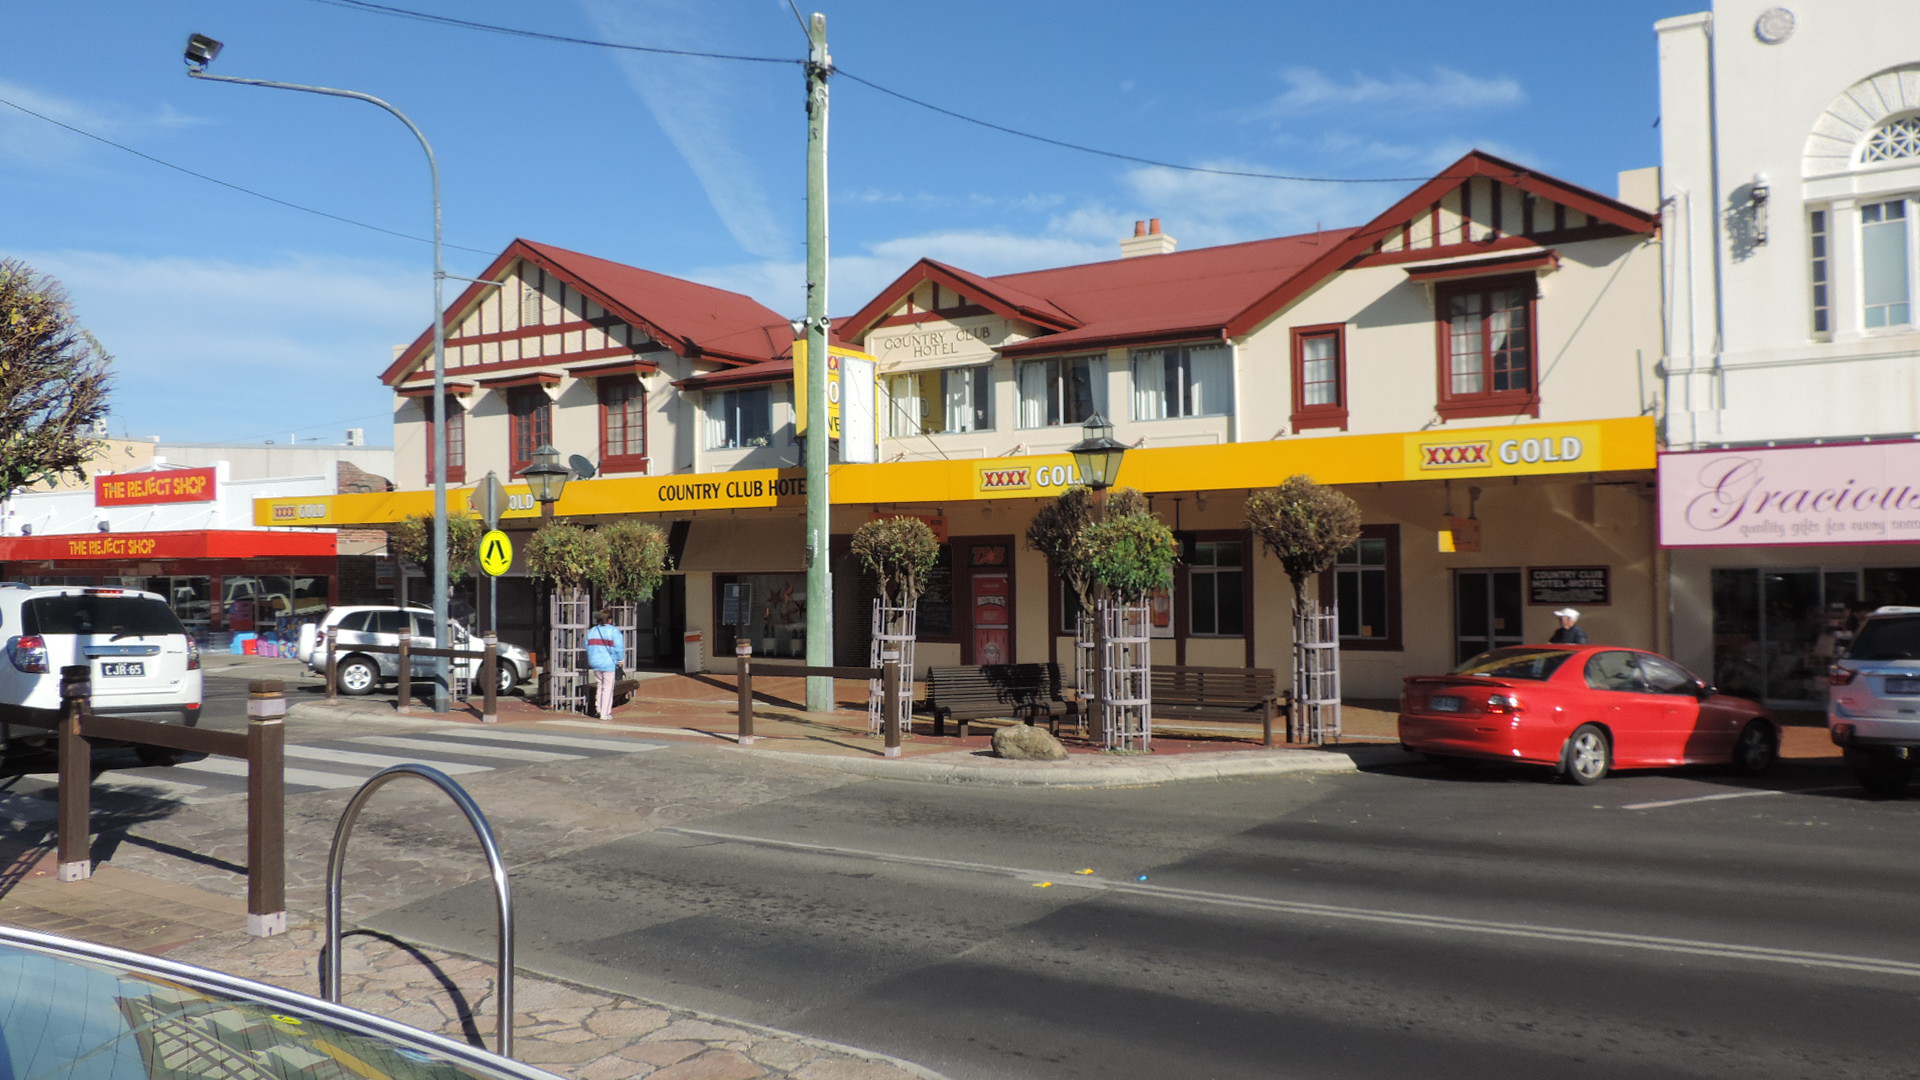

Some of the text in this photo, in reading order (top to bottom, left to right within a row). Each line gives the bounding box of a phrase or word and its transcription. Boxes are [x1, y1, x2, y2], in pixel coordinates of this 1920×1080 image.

[883, 327, 991, 350] COUNTRY CLUB
[913, 343, 958, 358] HOTEL
[1426, 436, 1583, 465] XXXX GOLD
[102, 475, 206, 498] THE REJECT SHOP
[983, 465, 1086, 487] XXXX GOL
[658, 477, 807, 502] COUNTRY CLUB HOTE
[299, 504, 326, 518] GOLD
[508, 494, 535, 510] OLD
[68, 537, 156, 555] THE REJECT SHOP
